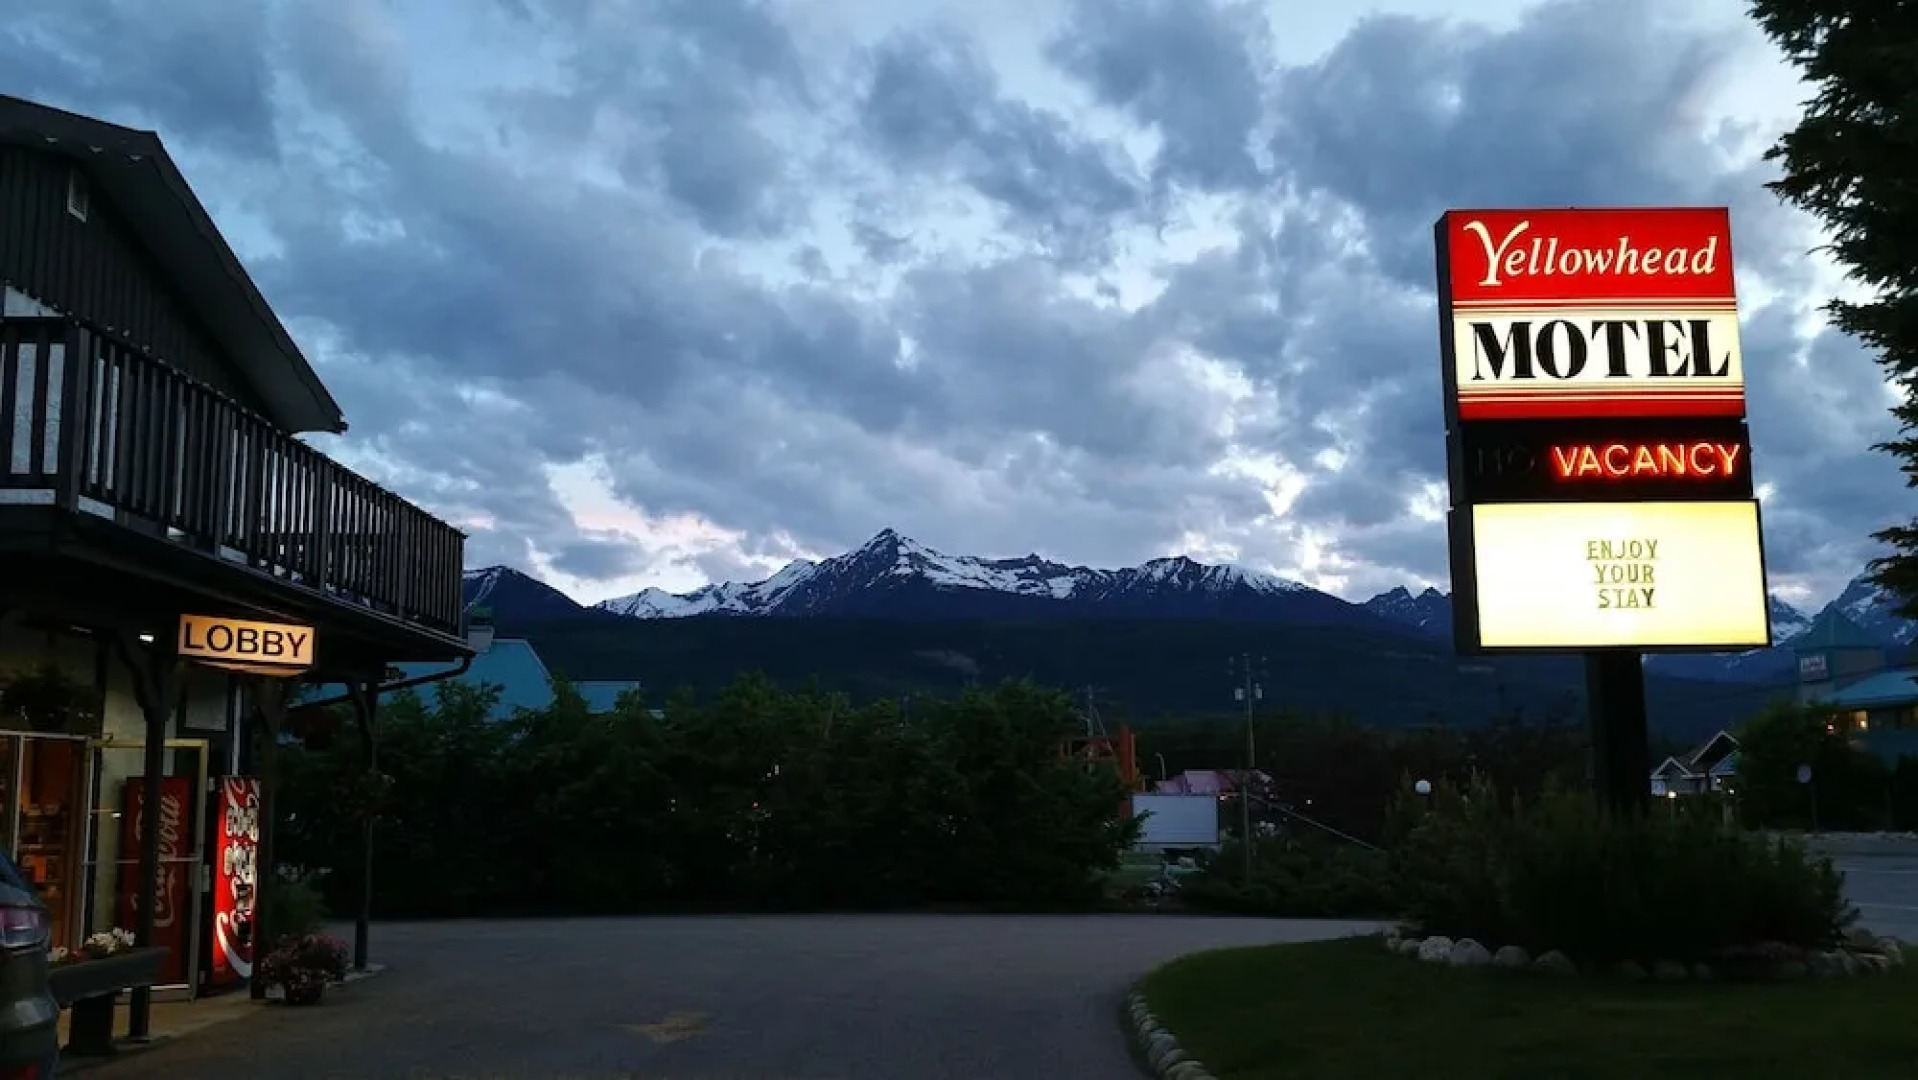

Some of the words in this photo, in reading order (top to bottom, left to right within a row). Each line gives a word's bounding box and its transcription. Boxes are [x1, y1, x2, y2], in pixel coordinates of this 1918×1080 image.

[1463, 220, 1717, 287] Yellowhead
[1469, 319, 1730, 380] MOTEL
[1554, 442, 1741, 477] VACANCY
[1587, 539, 1658, 560] ENJOY
[1594, 564, 1655, 584] YOUR
[1598, 588, 1655, 609] STAY
[183, 622, 308, 658] LOBBY
